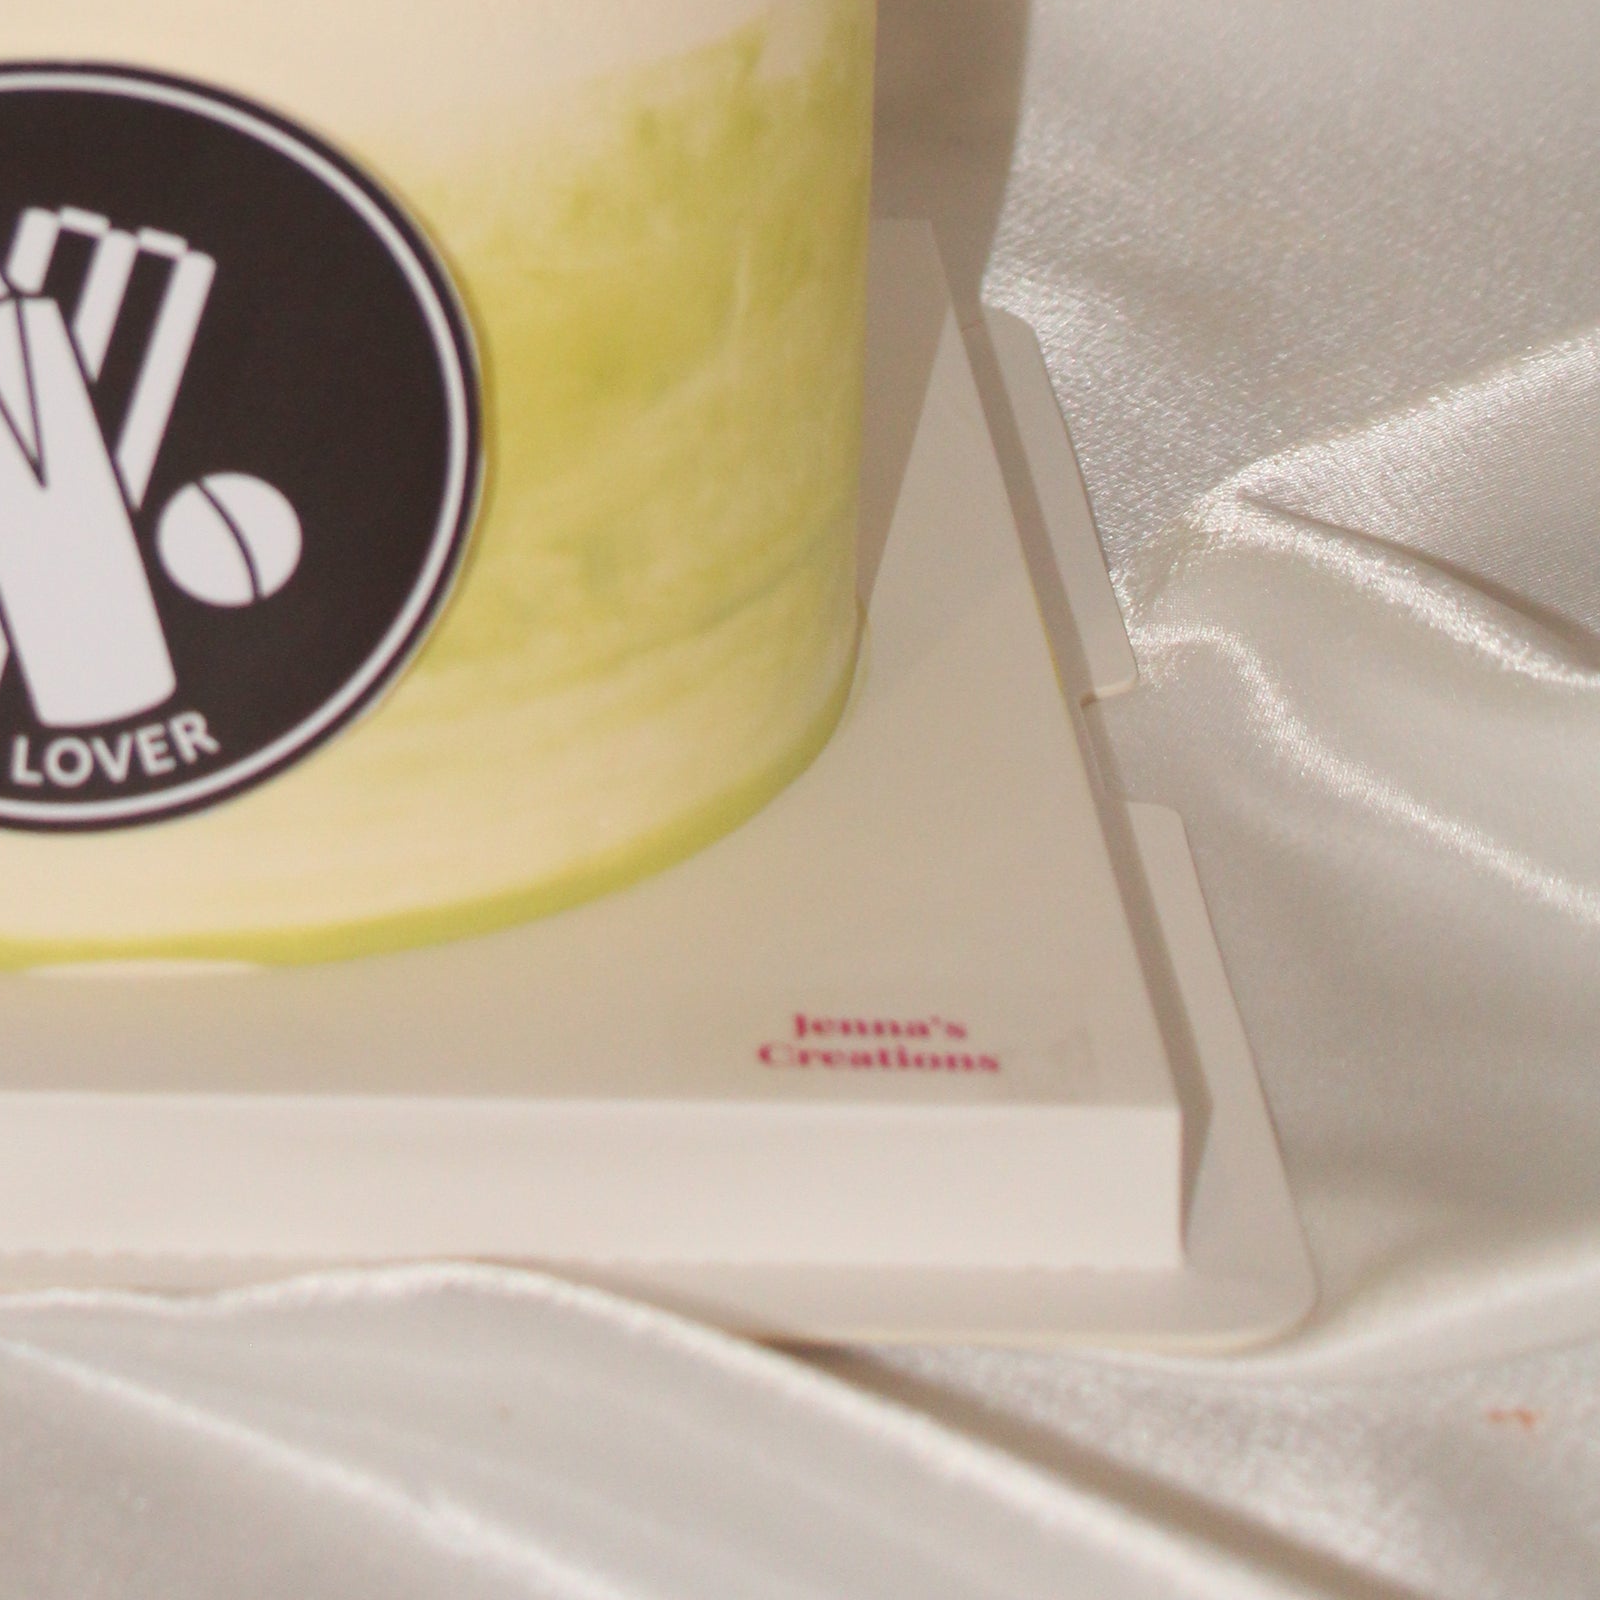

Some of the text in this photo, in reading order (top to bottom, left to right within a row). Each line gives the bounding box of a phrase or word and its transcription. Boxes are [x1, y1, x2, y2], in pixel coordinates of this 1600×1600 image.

[11, 711, 220, 788] LOVER
[793, 1012, 967, 1041] Jenna's
[757, 1043, 1000, 1072] Creations
